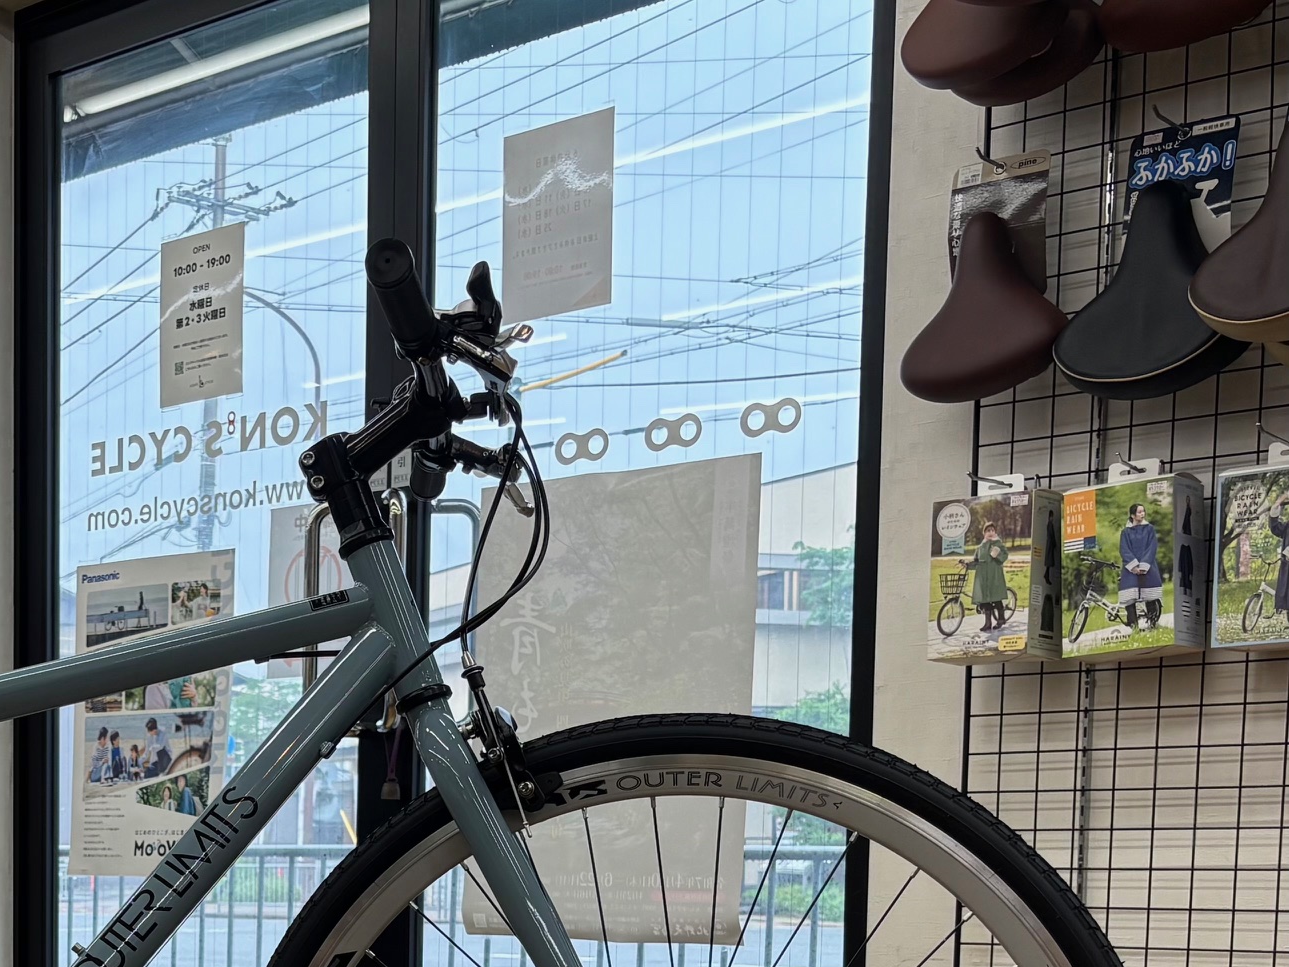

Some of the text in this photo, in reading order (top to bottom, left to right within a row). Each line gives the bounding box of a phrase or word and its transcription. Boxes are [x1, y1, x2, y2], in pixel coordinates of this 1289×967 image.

[1018, 158, 1038, 169] pine
[192, 244, 211, 255] OPEN
[173, 262, 198, 278] 10:00
[206, 253, 231, 269] 19:00
[189, 297, 213, 312] 水曜日
[81, 571, 120, 584] Panasonic
[615, 771, 829, 809] OUTER LIMITS
[153, 785, 259, 899] LIMITS
